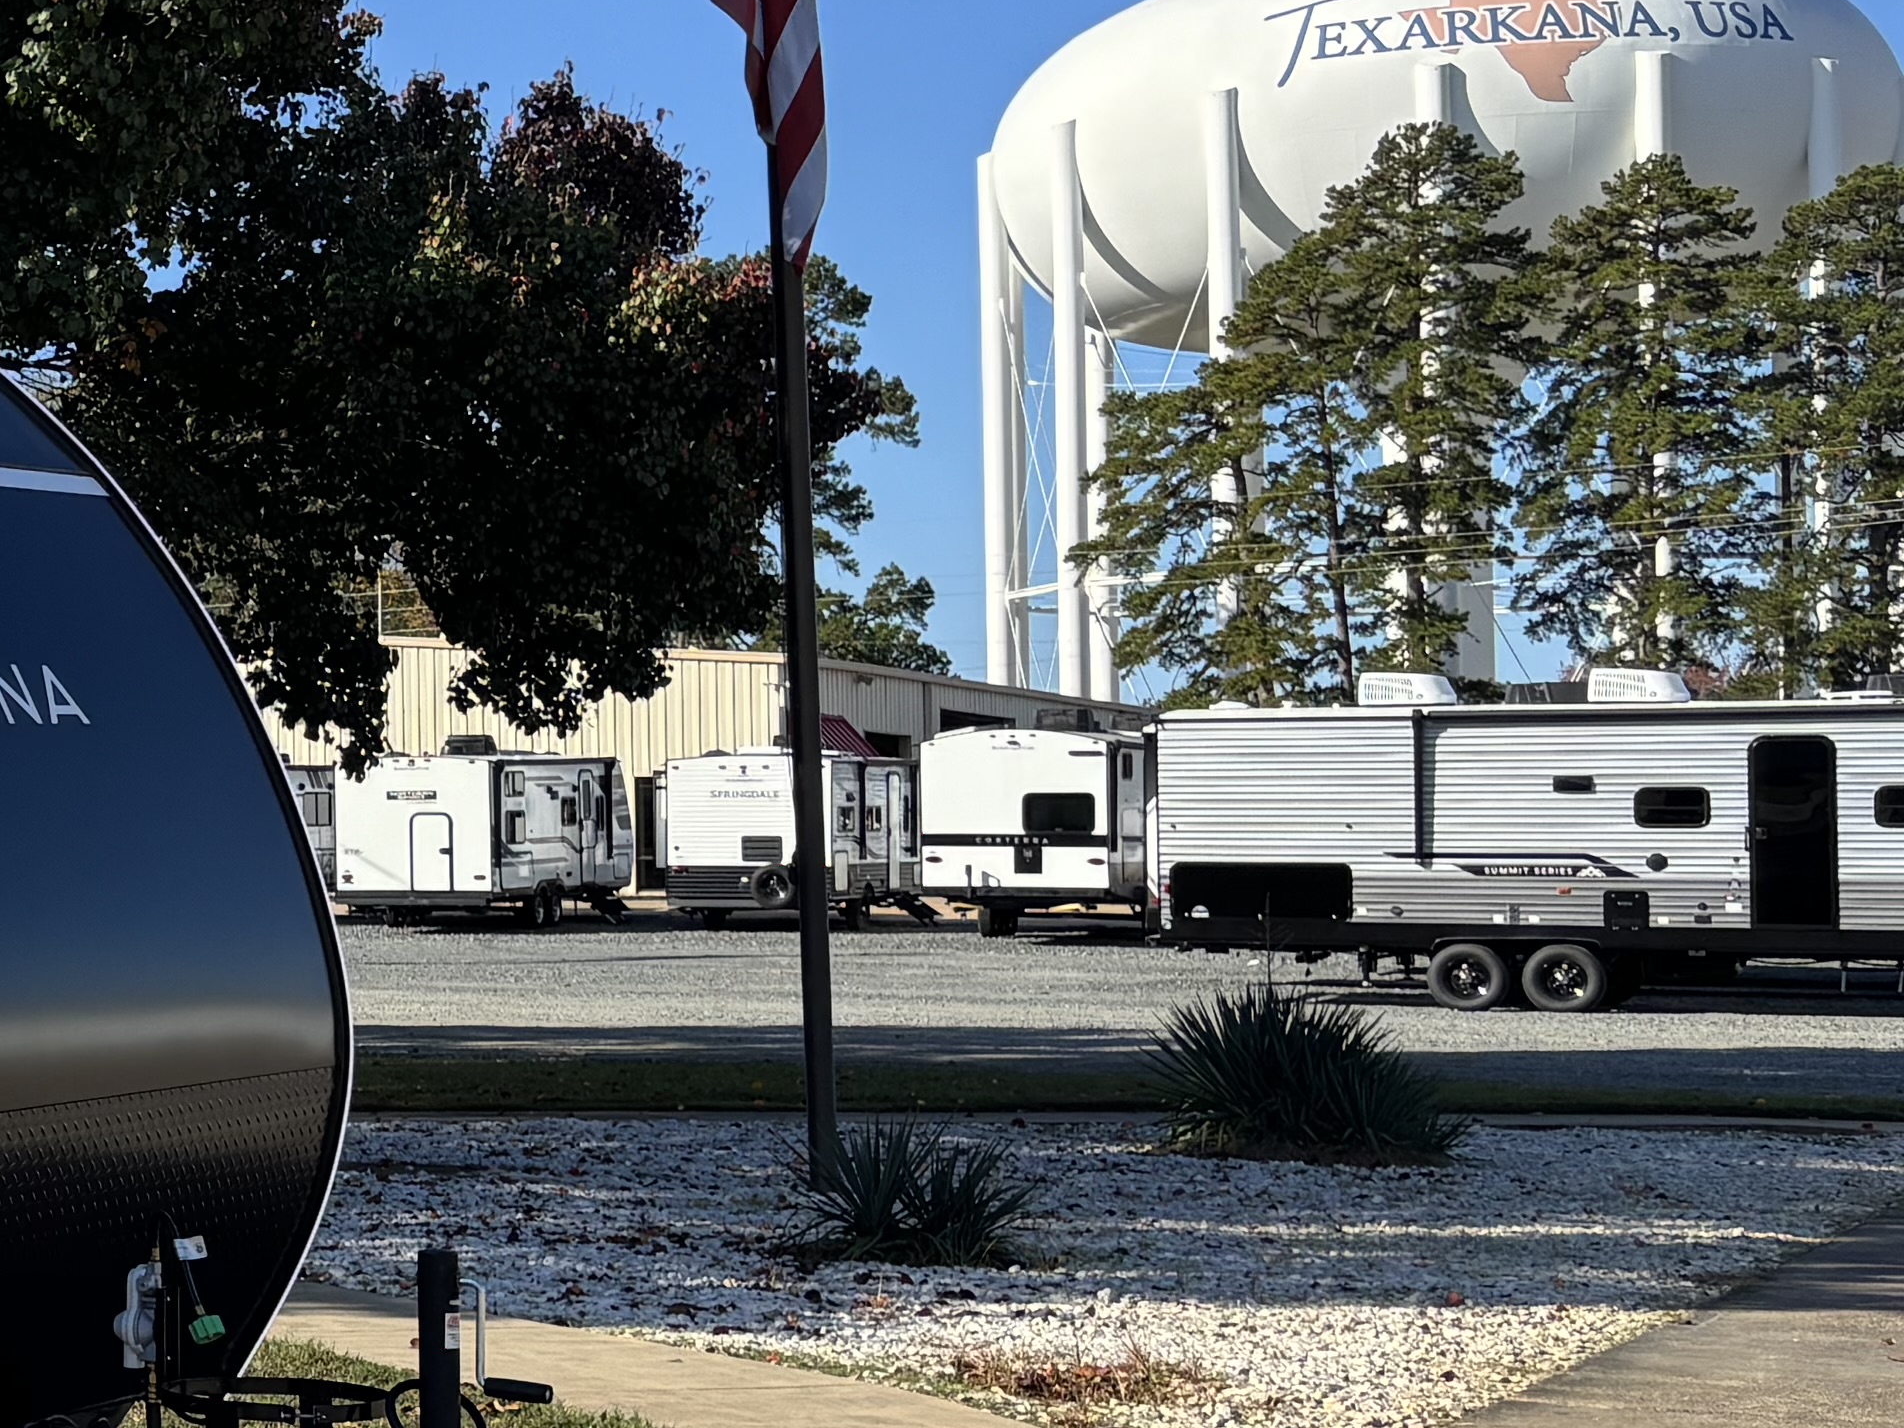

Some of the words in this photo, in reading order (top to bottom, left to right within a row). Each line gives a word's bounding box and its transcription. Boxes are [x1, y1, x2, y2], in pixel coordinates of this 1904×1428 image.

[1692, 0, 1794, 42] USA
[709, 790, 780, 799] SPRINGDALE
[1484, 866, 1530, 876] SUMMIT
